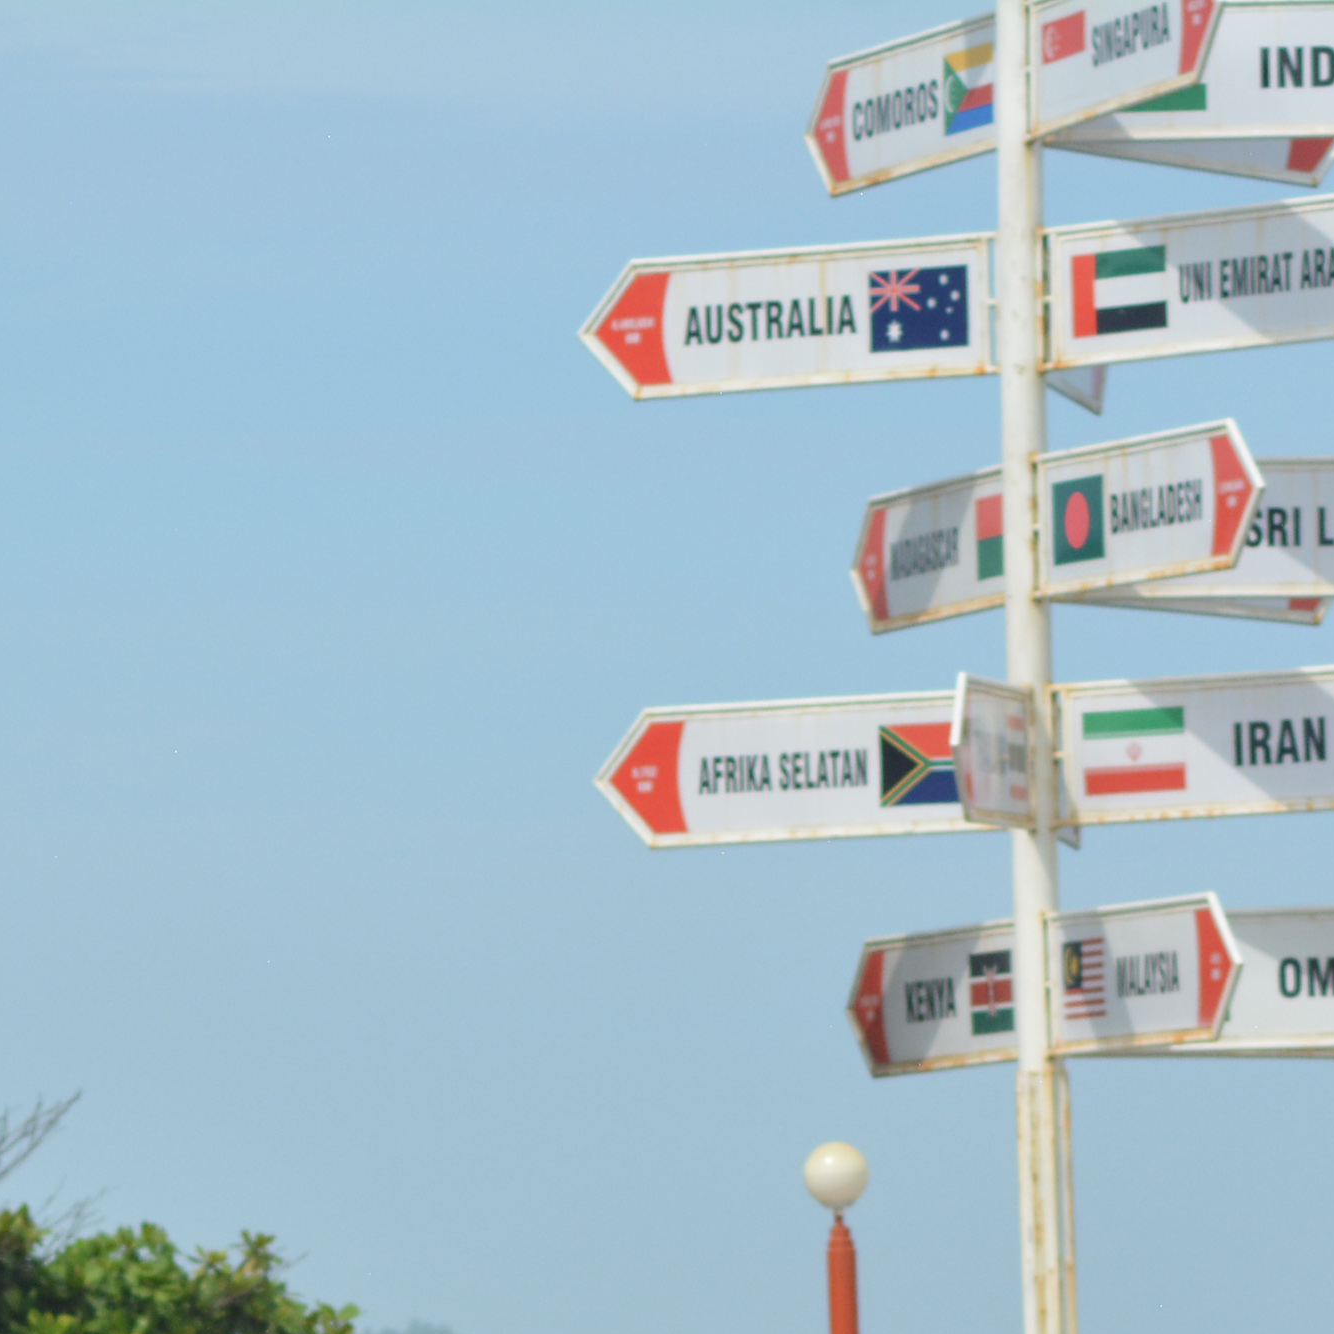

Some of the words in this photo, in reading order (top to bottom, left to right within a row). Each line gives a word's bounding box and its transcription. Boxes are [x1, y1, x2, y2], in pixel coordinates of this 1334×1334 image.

[1092, 1, 1170, 67] SINGAPURA
[852, 79, 939, 141] COMOROS
[1179, 262, 1212, 303] UNI
[1220, 252, 1293, 298] EMIRAT
[684, 295, 857, 346] AUSTRALIA
[1110, 479, 1202, 534] BANGLADESH
[1246, 507, 1302, 548] SRI
[1234, 717, 1327, 767] IRAN
[699, 754, 773, 795] AFRIKA
[779, 749, 868, 790] SELATAN
[1116, 950, 1179, 998] MALAYSIA
[906, 977, 957, 1023] KENYA
